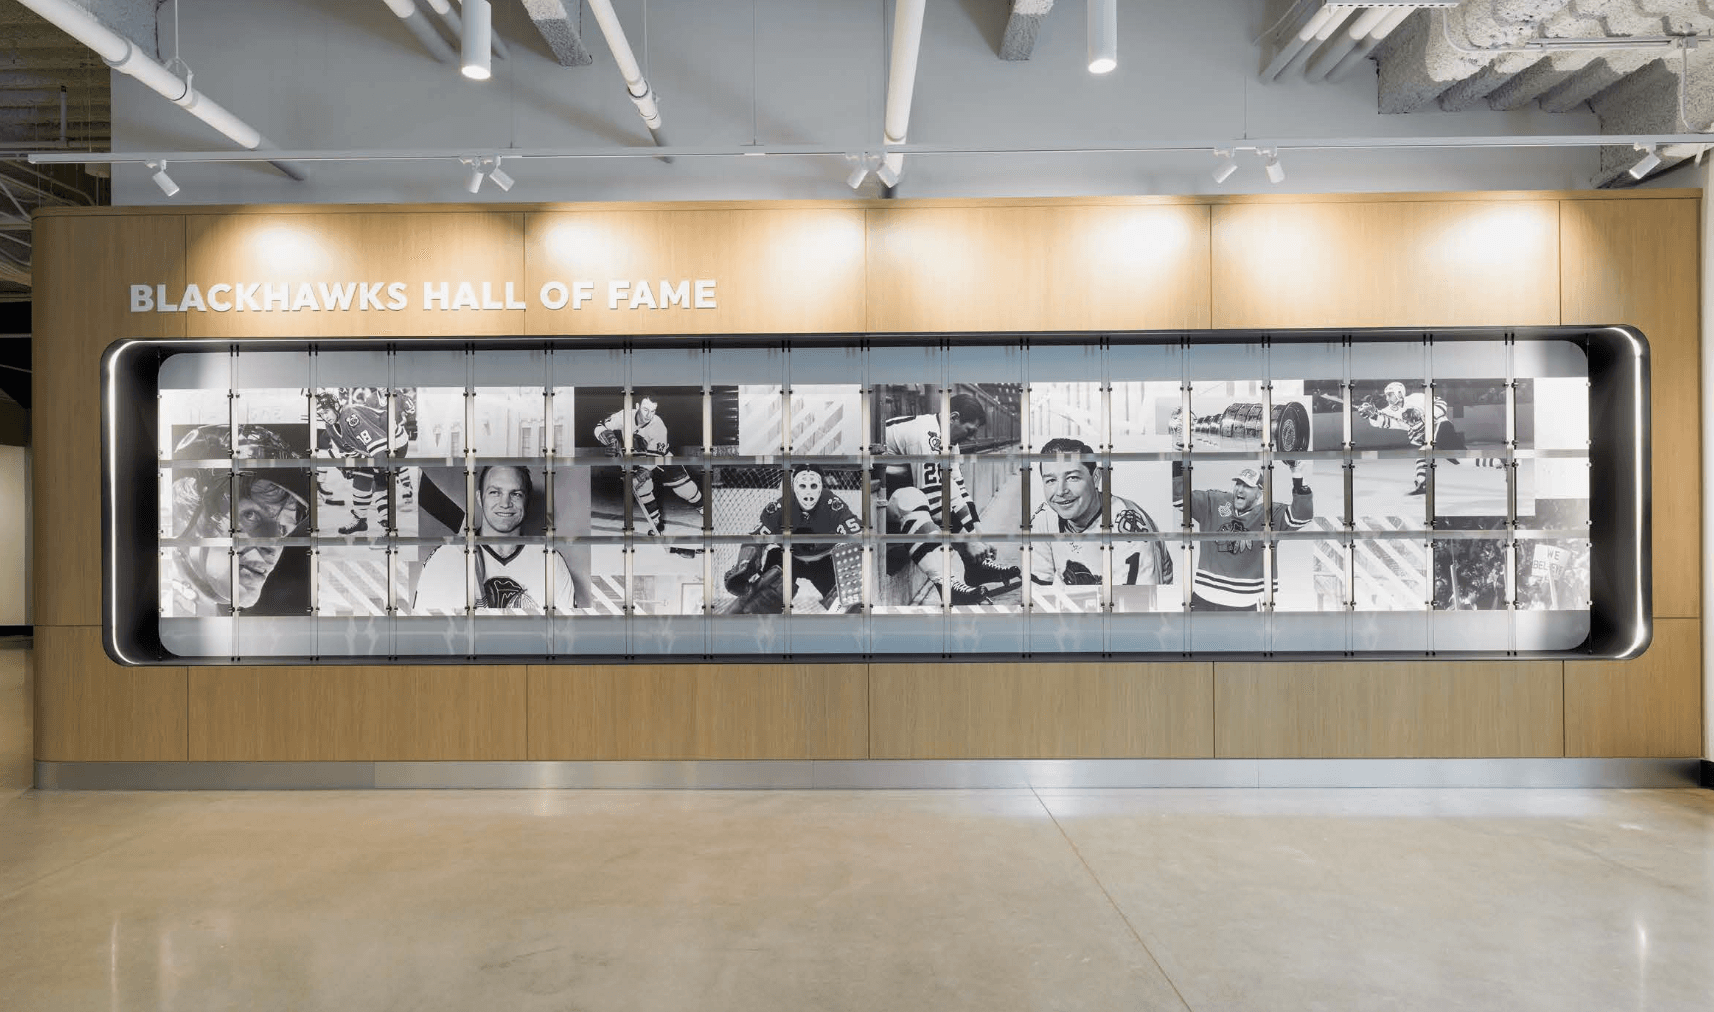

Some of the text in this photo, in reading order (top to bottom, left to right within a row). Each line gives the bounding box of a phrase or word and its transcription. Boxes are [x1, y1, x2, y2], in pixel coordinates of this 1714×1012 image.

[130, 279, 718, 313] BLACKHAWKS HALL OF FAME
[356, 429, 373, 446] 18
[1547, 546, 1561, 561] WE
